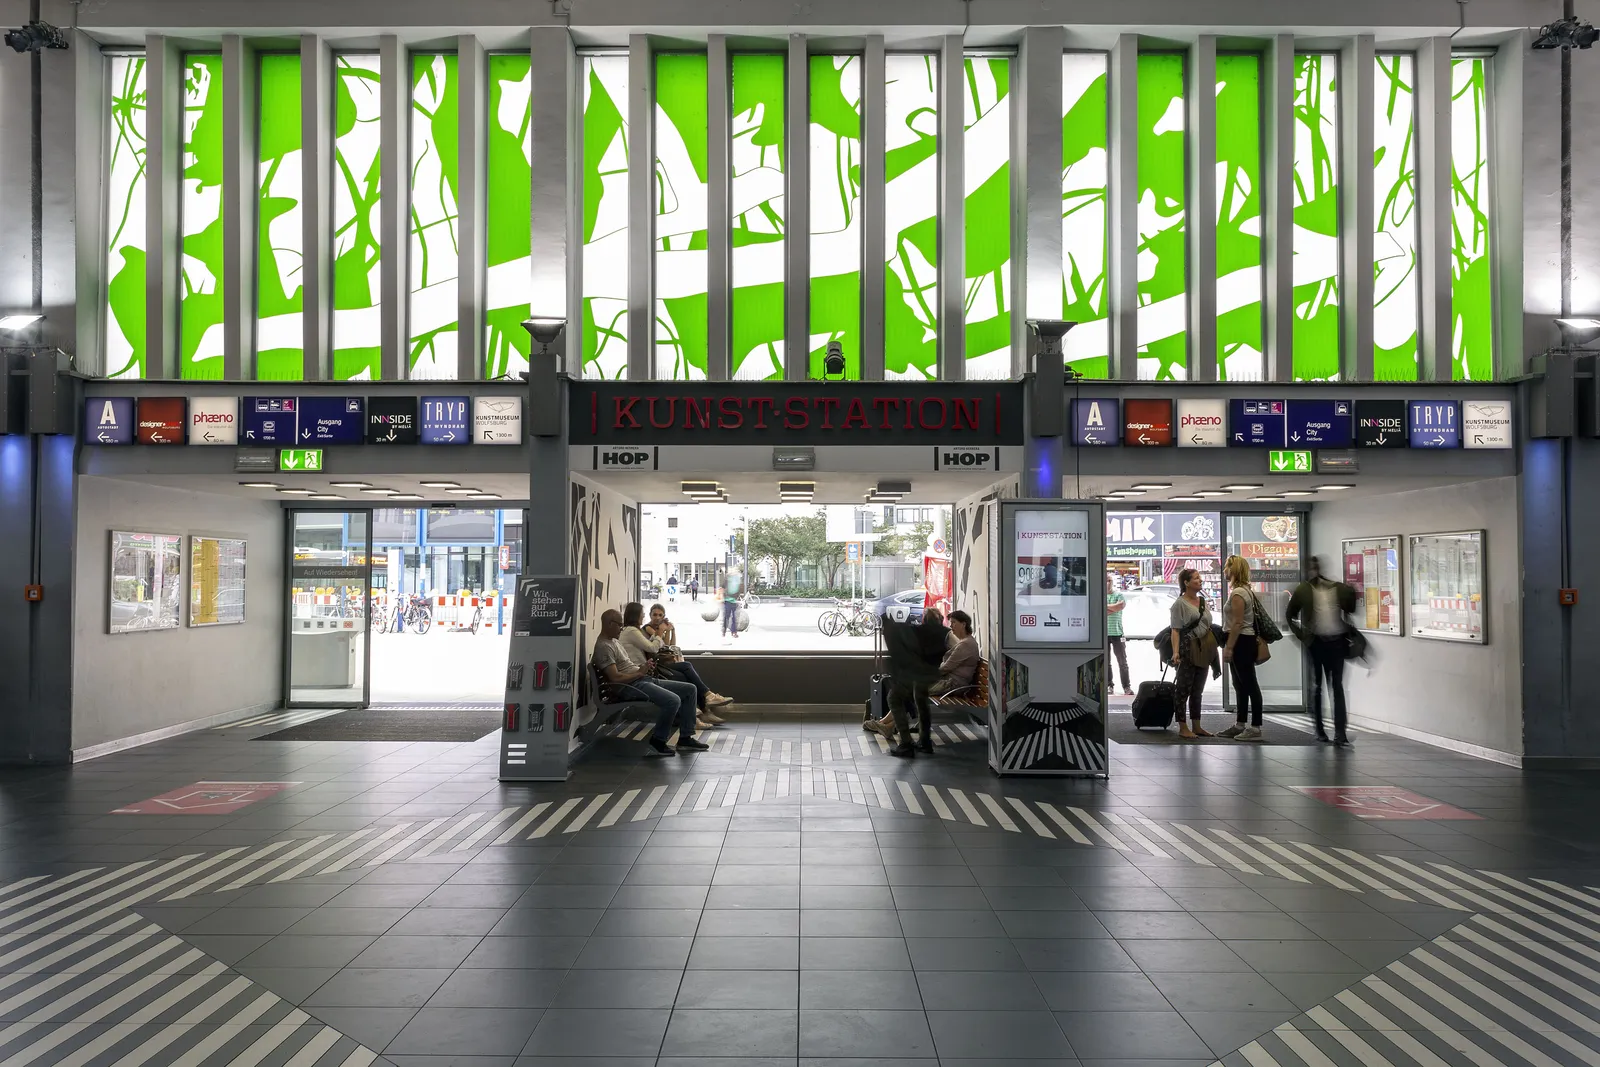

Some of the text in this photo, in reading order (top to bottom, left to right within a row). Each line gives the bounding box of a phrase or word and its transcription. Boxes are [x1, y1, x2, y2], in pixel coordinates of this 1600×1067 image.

[100, 400, 116, 425] A
[424, 402, 465, 421] TRYP
[1086, 402, 1103, 426] A
[1413, 406, 1454, 425] TRYP
[193, 411, 234, 426] phæno
[317, 418, 342, 426] Ausgang
[371, 415, 412, 424] INNSIDE
[1181, 414, 1222, 428] phæno
[1306, 421, 1331, 429] Ausgang
[1360, 418, 1401, 427] INNSIDE
[317, 425, 328, 433] City
[602, 452, 649, 465] HOP
[944, 453, 990, 466] HOP
[1113, 546, 1157, 556] Funshopping
[1248, 543, 1282, 557] Pizza
[1184, 559, 1214, 572] MIK
[1022, 616, 1035, 625] DB
